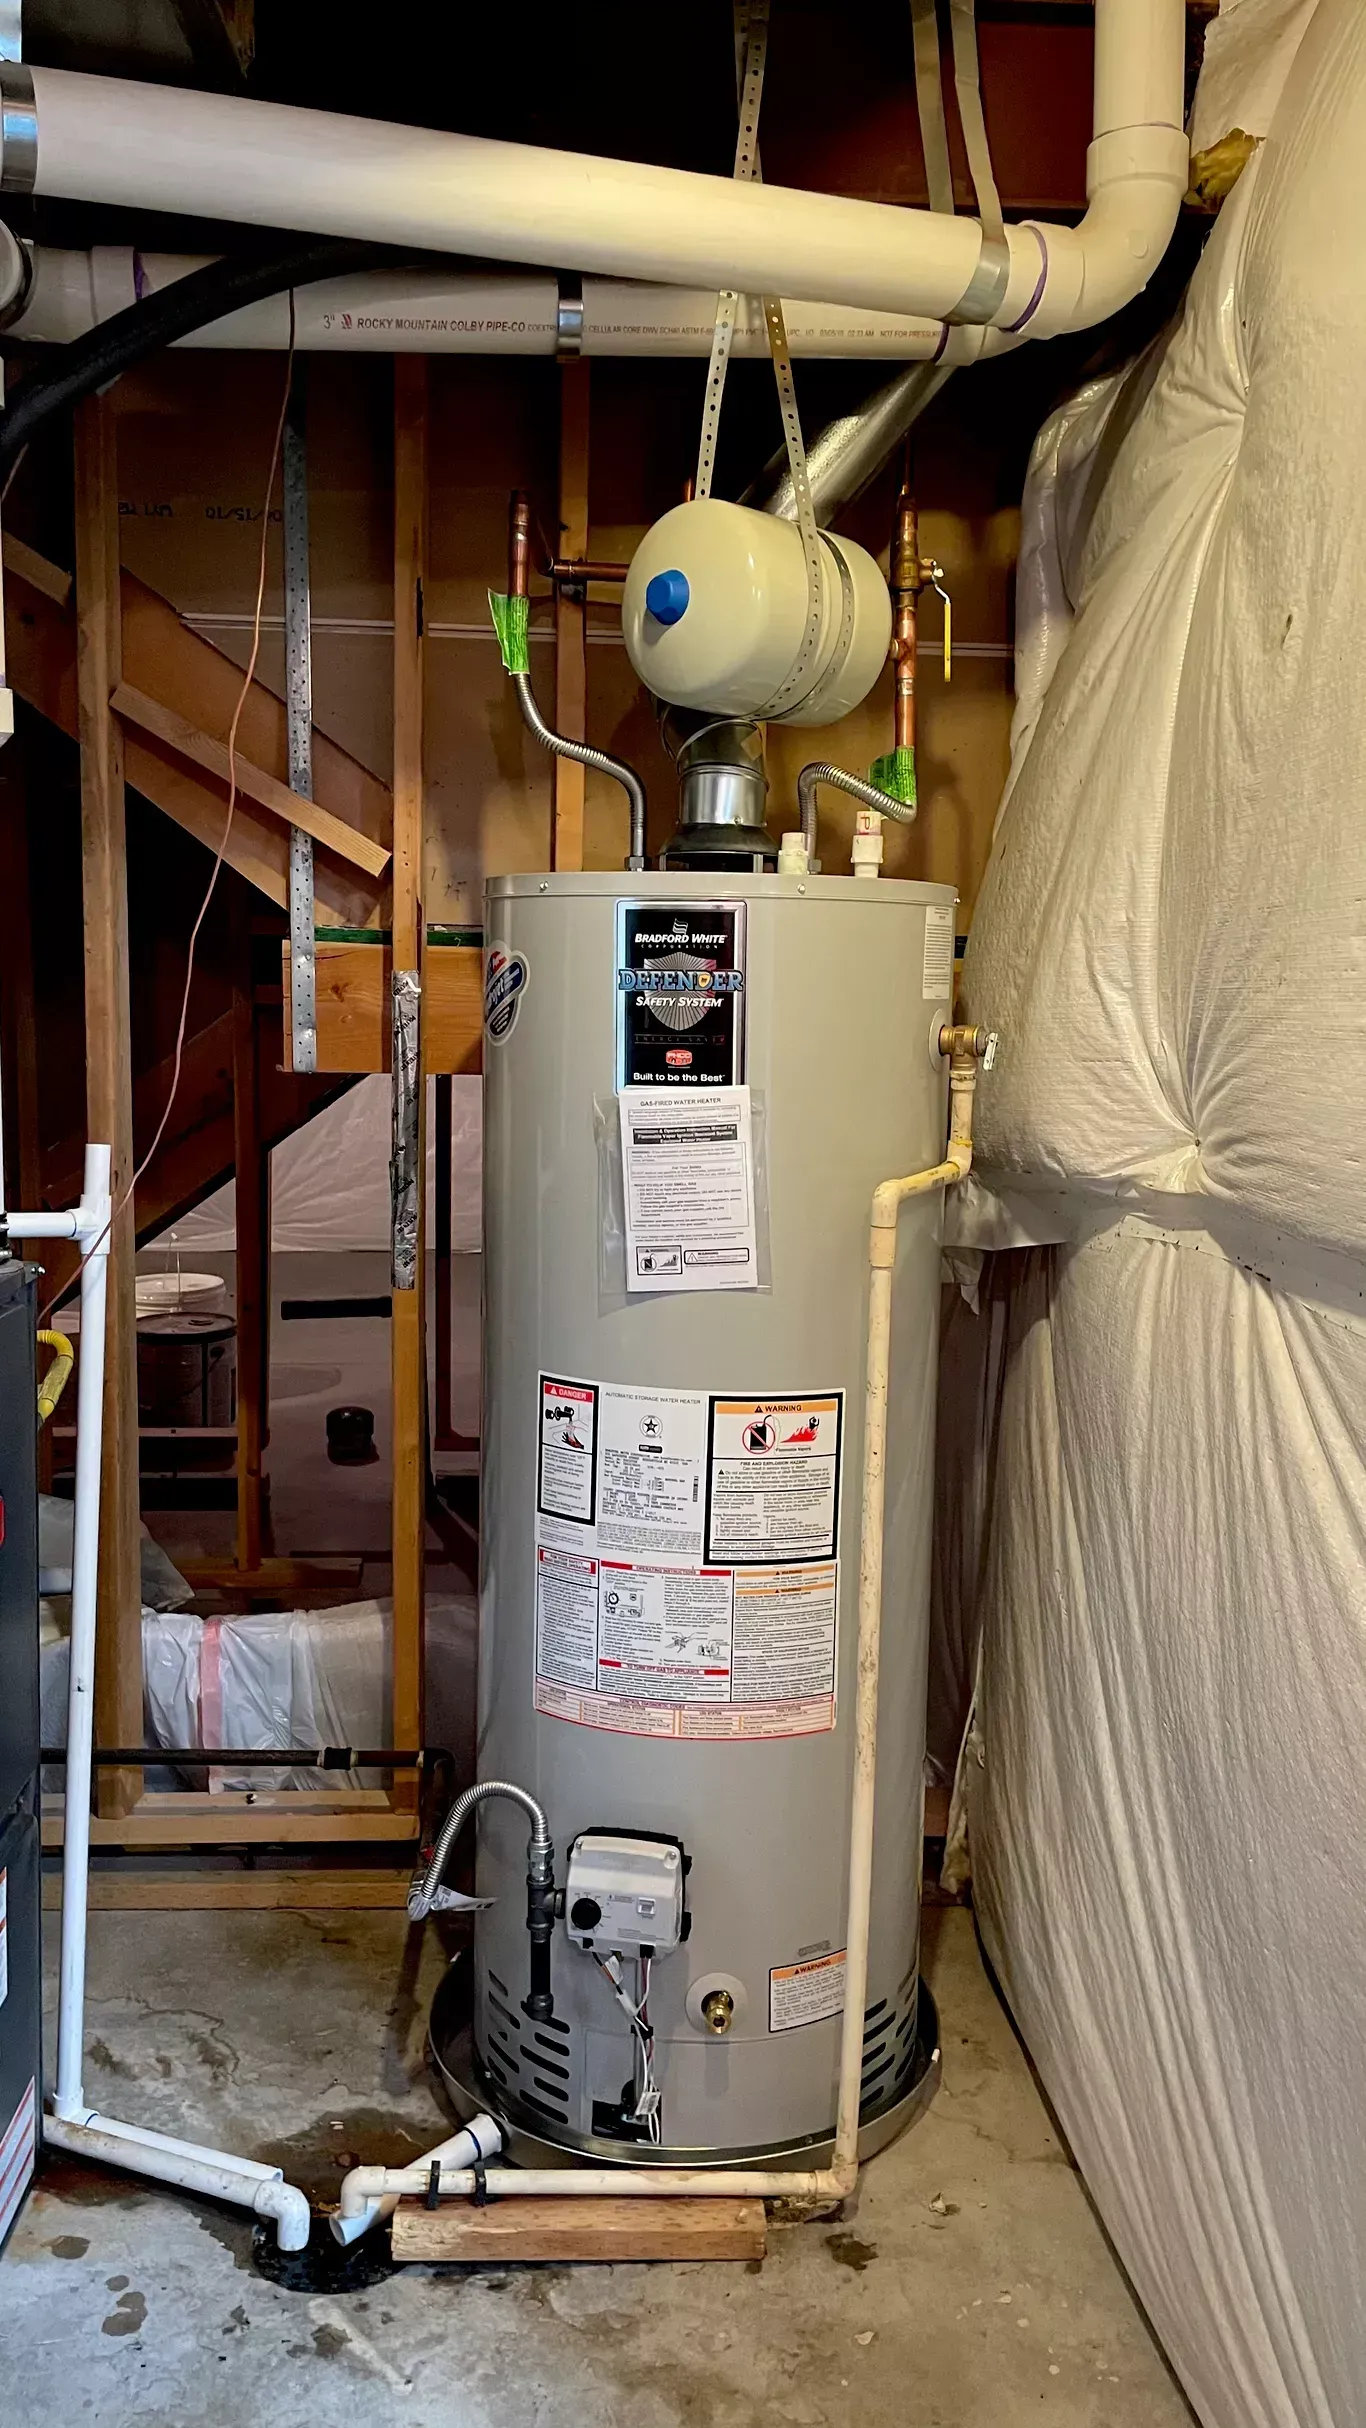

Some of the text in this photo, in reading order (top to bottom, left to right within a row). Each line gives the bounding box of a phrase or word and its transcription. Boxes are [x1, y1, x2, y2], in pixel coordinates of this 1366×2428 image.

[323, 314, 335, 330] 3"
[357, 318, 392, 330] ROCKY
[396, 319, 450, 330] MOUNTAIN
[450, 320, 484, 332] COLBY
[486, 321, 526, 332] PIPE-CO
[635, 933, 689, 944] BRADFORD
[619, 970, 744, 991] DEFENDER
[636, 996, 676, 1007] SAFETY
[633, 1072, 653, 1081] Built
[668, 1073, 680, 1081] be
[682, 1074, 698, 1082] the
[559, 1388, 586, 1400] DANGER
[800, 1959, 831, 1972] WARNING
